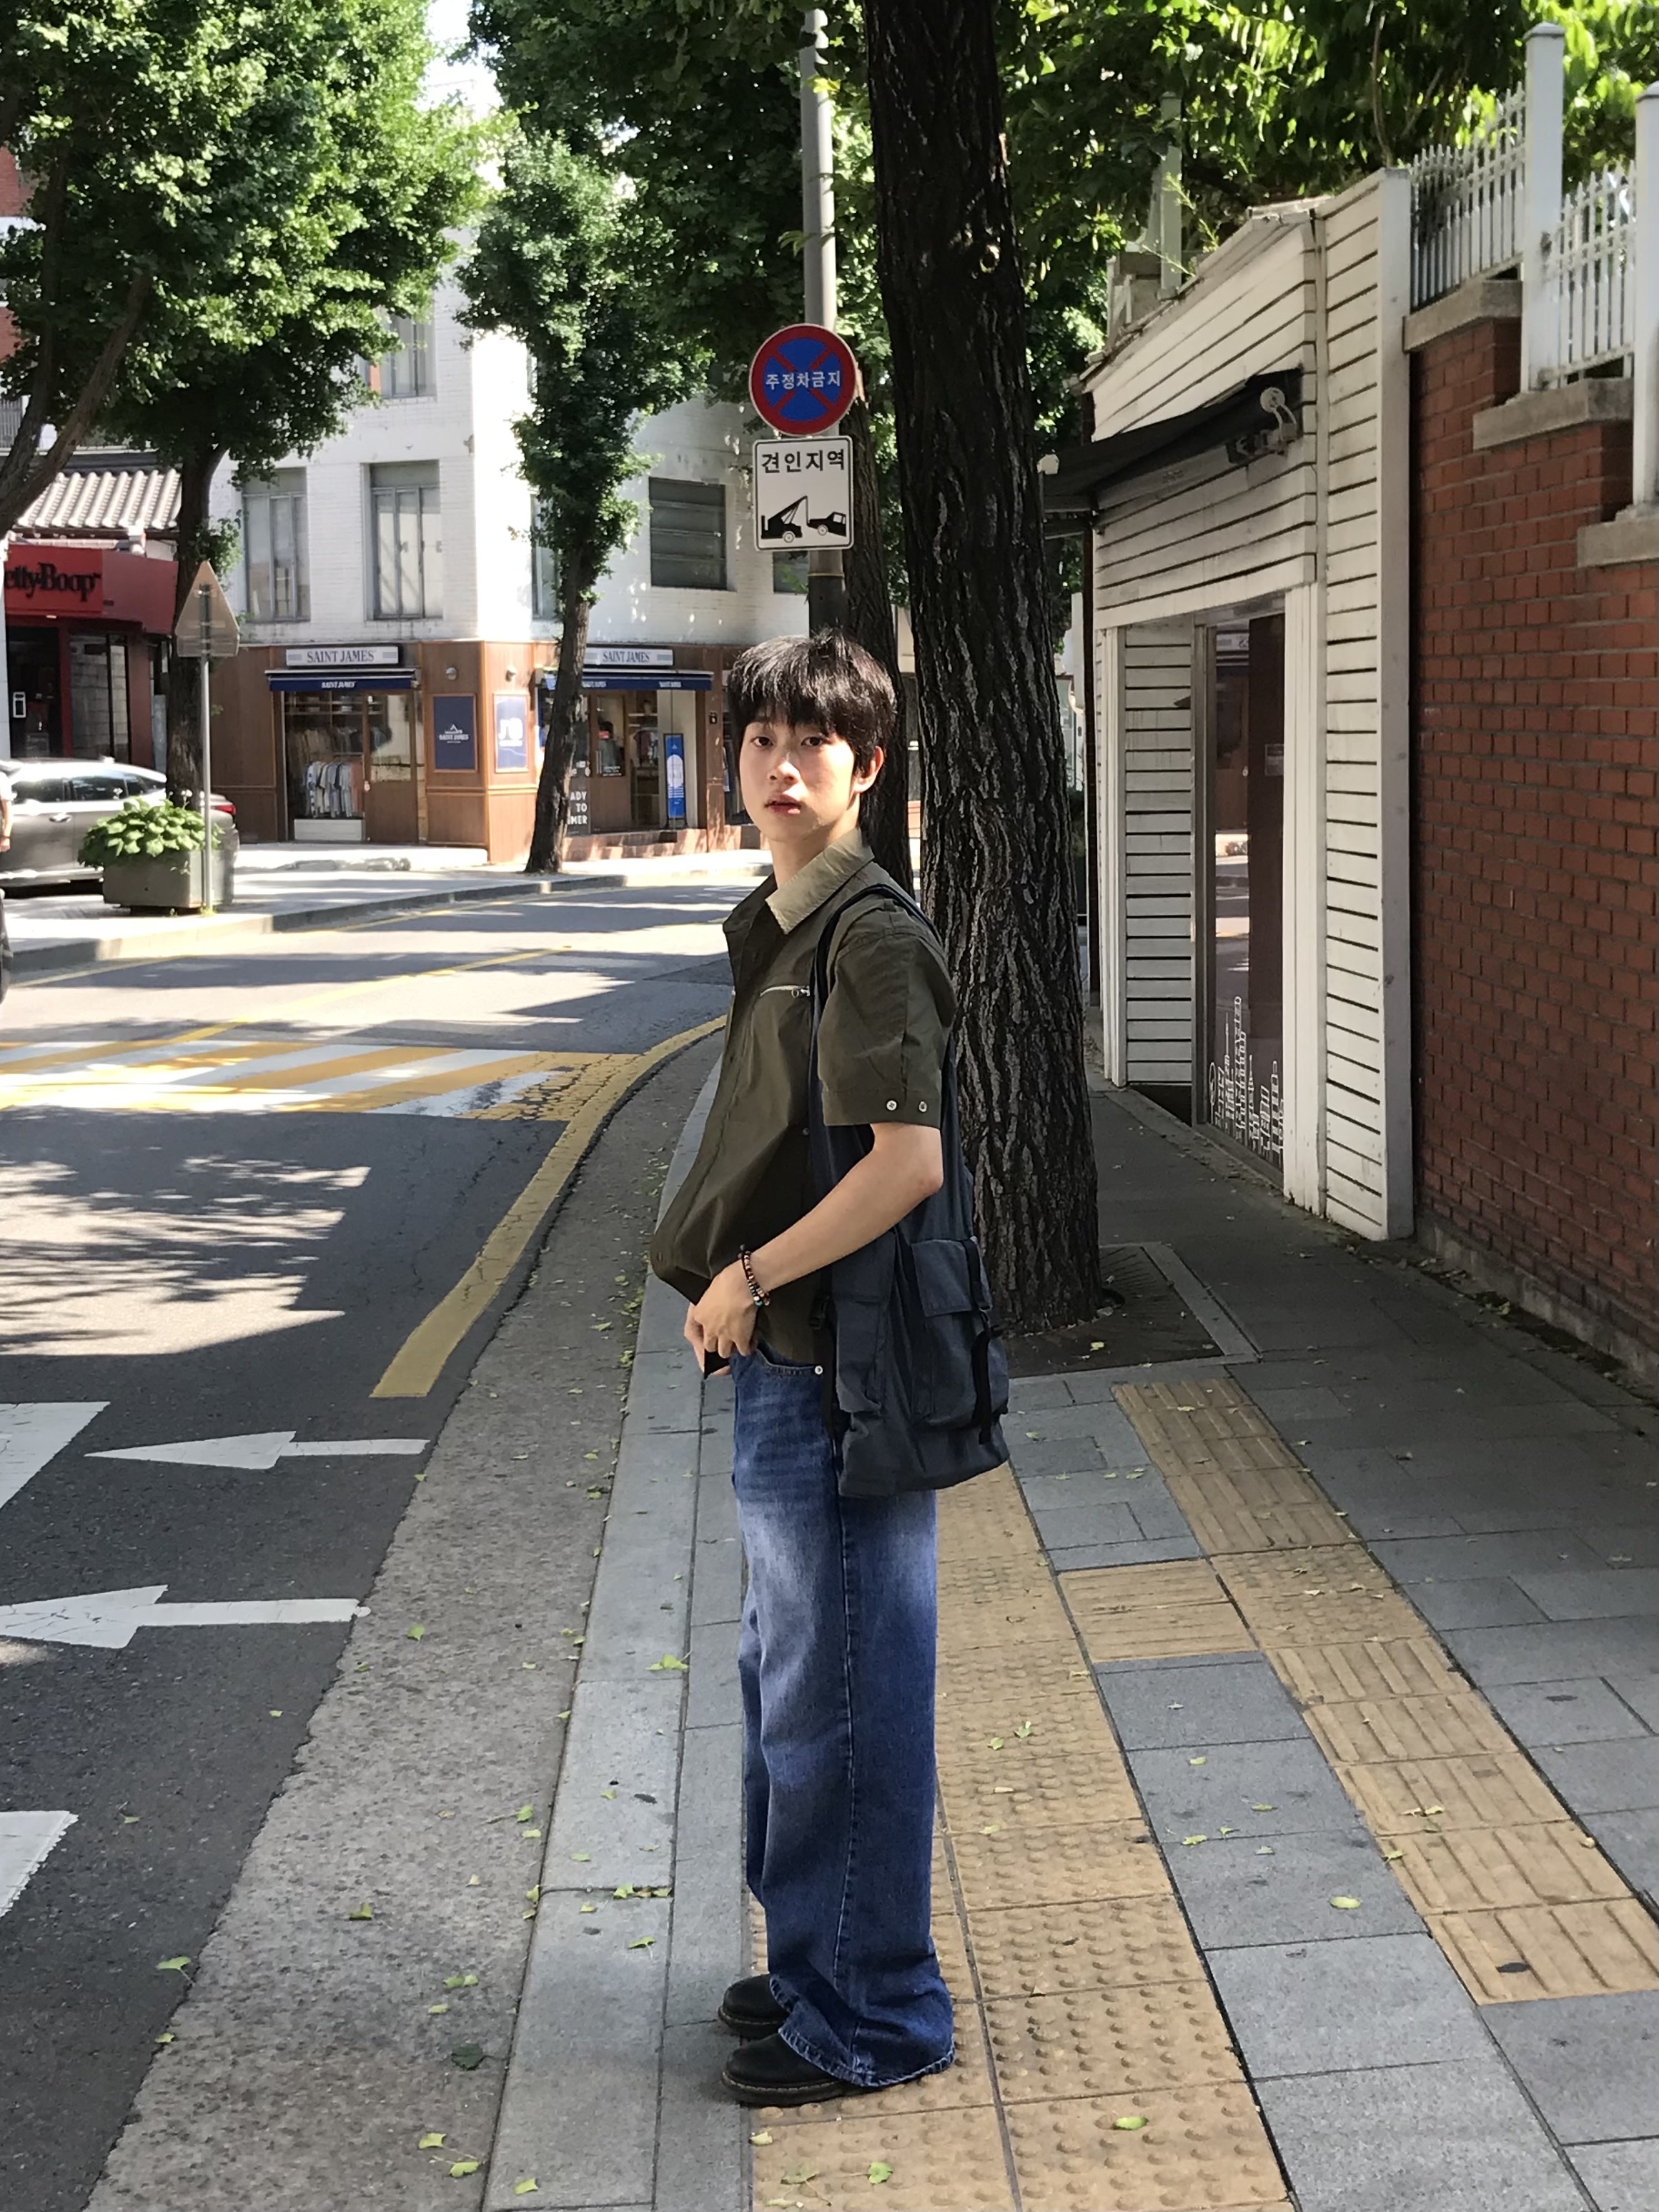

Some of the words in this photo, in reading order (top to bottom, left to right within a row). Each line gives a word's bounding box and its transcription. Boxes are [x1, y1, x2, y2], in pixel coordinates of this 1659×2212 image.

[766, 370, 841, 390] 주정차금지
[761, 448, 844, 473] 견인지역
[307, 650, 338, 663] SAINT
[340, 650, 375, 663] JAMES
[603, 650, 624, 663] SAINT
[626, 651, 650, 663] JAMES
[570, 791, 587, 800] ADY
[575, 803, 588, 813] TO
